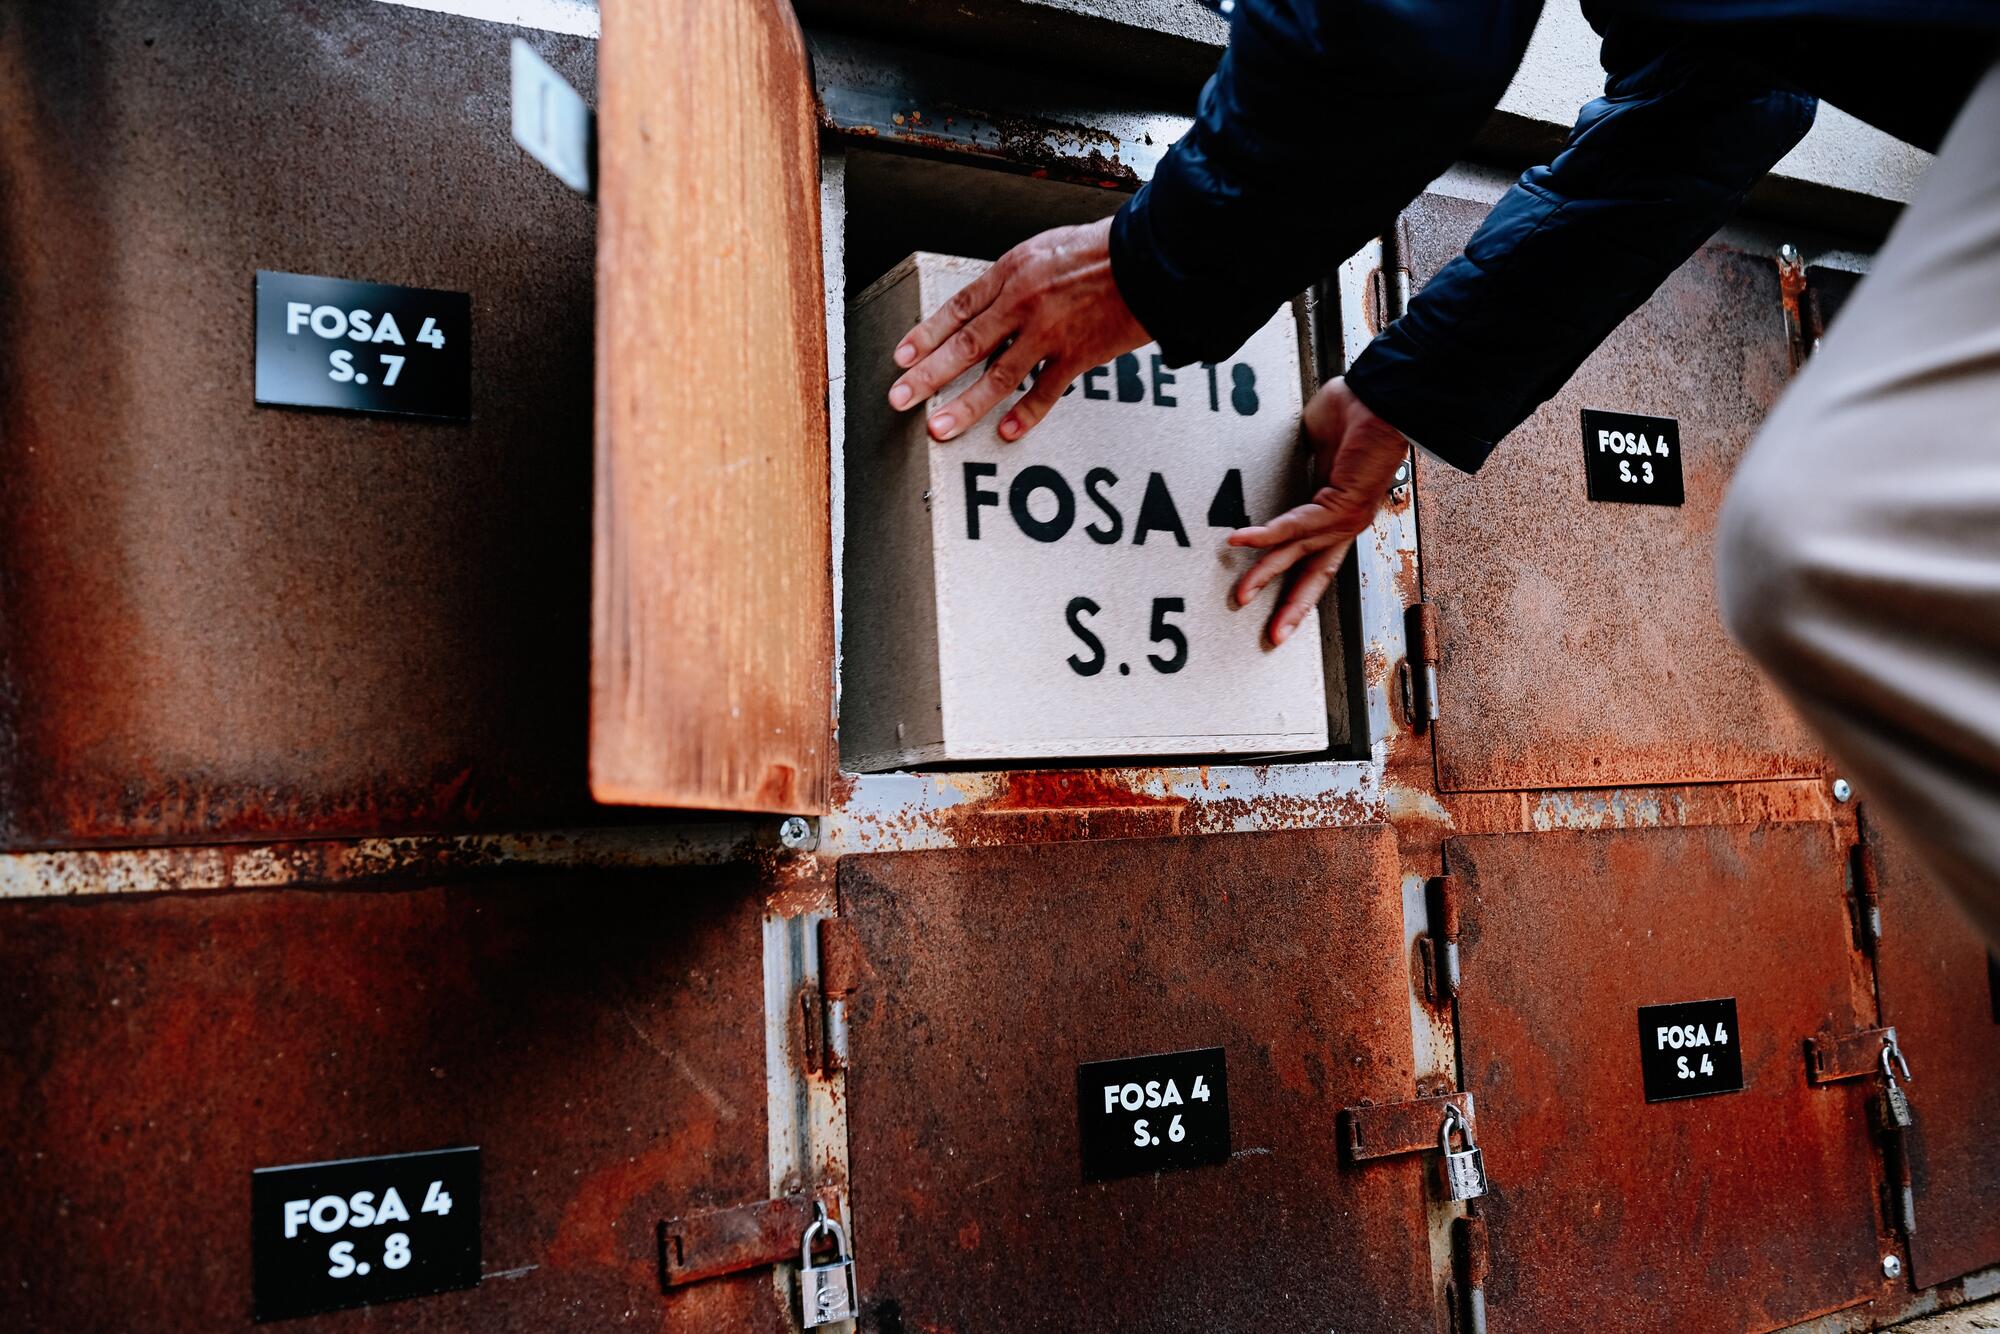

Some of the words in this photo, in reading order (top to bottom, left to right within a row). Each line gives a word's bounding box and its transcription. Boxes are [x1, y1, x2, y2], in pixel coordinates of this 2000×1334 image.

[286, 301, 405, 346] FOSA
[416, 317, 446, 350] 4
[328, 349, 369, 384] S.
[380, 354, 406, 386] 7
[1201, 361, 1259, 416] 18
[1598, 429, 1652, 457] FOSA
[1655, 435, 1670, 459] 4
[1619, 459, 1638, 484] S.
[1641, 461, 1654, 485] 3
[962, 461, 1191, 548] FOSA
[1207, 468, 1252, 530] 4
[1657, 1023, 1711, 1050] FOSA
[1714, 1022, 1728, 1045] 4
[1676, 1055, 1696, 1079] S.
[1699, 1053, 1714, 1076] 4
[1104, 1078, 1184, 1114] FOSA
[1191, 1075, 1211, 1102] 4
[1133, 1119, 1160, 1147] S.
[1168, 1114, 1186, 1143] 6
[284, 1187, 410, 1239] FOSA
[421, 1180, 453, 1216] 4
[328, 1241, 371, 1278] S.
[384, 1232, 412, 1270] 8
